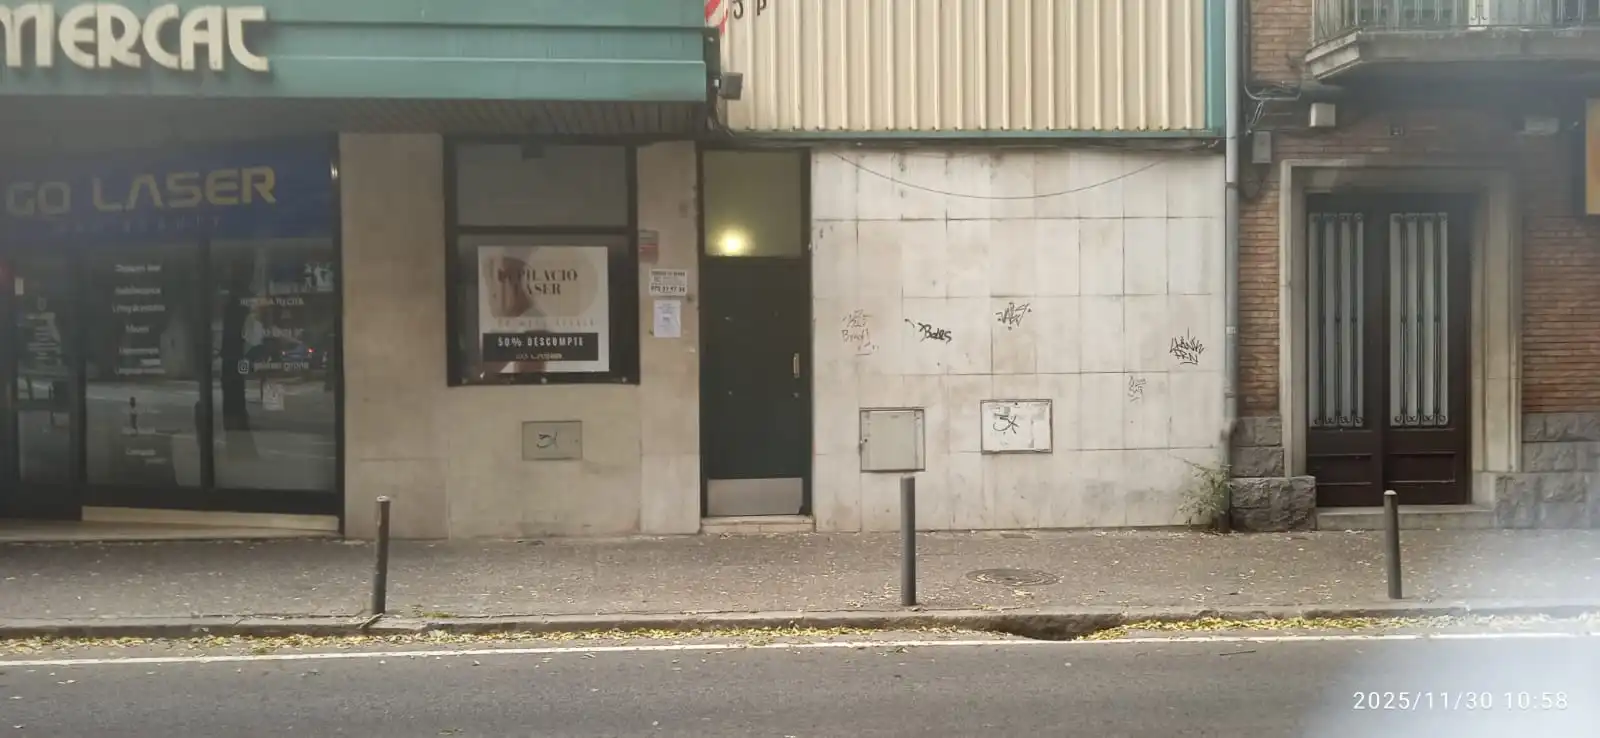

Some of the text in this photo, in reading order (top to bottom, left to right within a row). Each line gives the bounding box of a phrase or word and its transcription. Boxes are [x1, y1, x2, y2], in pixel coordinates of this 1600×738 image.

[0, 3, 269, 71] MERCAT
[6, 166, 276, 216] GO LASER
[498, 337, 523, 347] 50%
